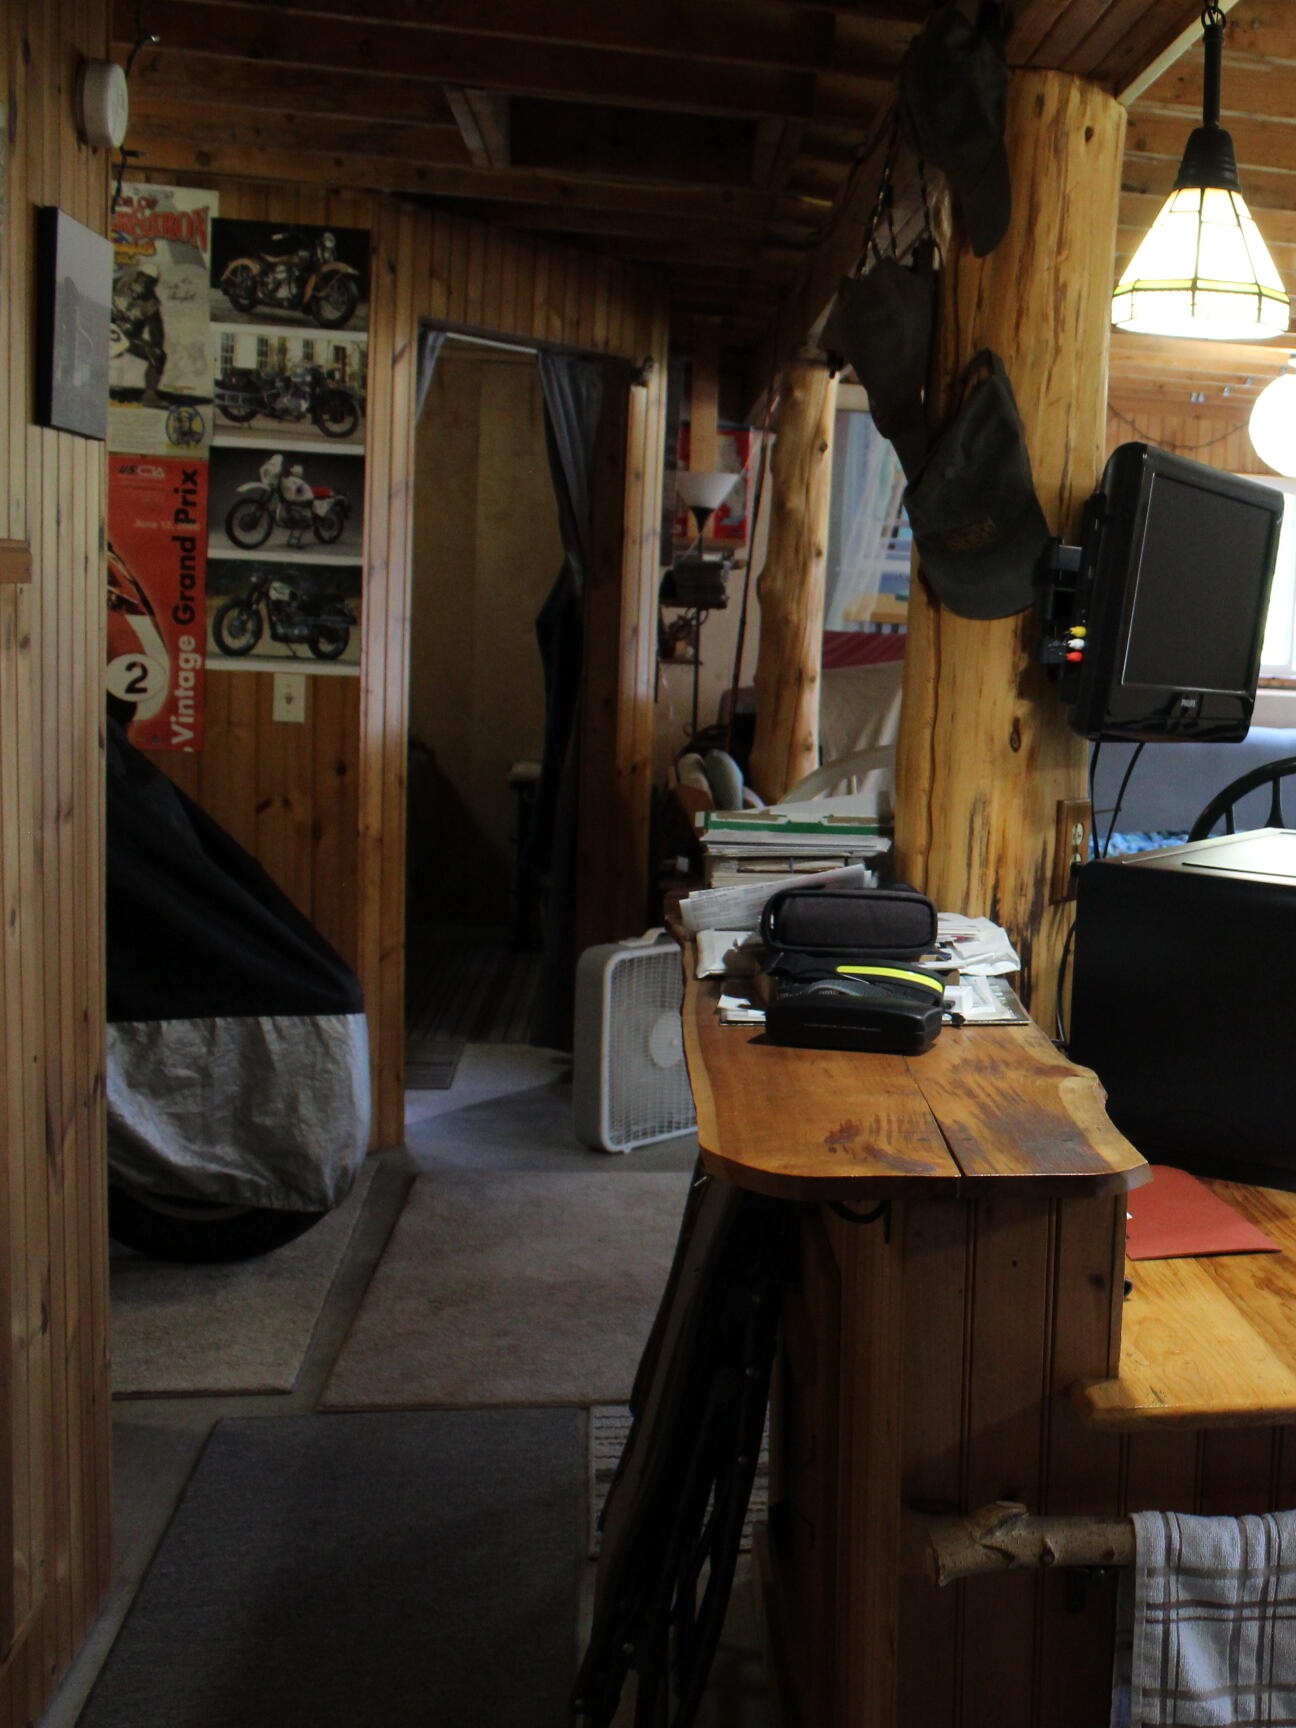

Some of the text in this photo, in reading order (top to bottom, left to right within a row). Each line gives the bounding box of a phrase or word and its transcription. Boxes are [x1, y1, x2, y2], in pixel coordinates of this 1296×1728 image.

[173, 468, 198, 523] Prix
[171, 536, 197, 626] Grand
[125, 662, 148, 694] 2
[169, 635, 202, 745] Vintage
